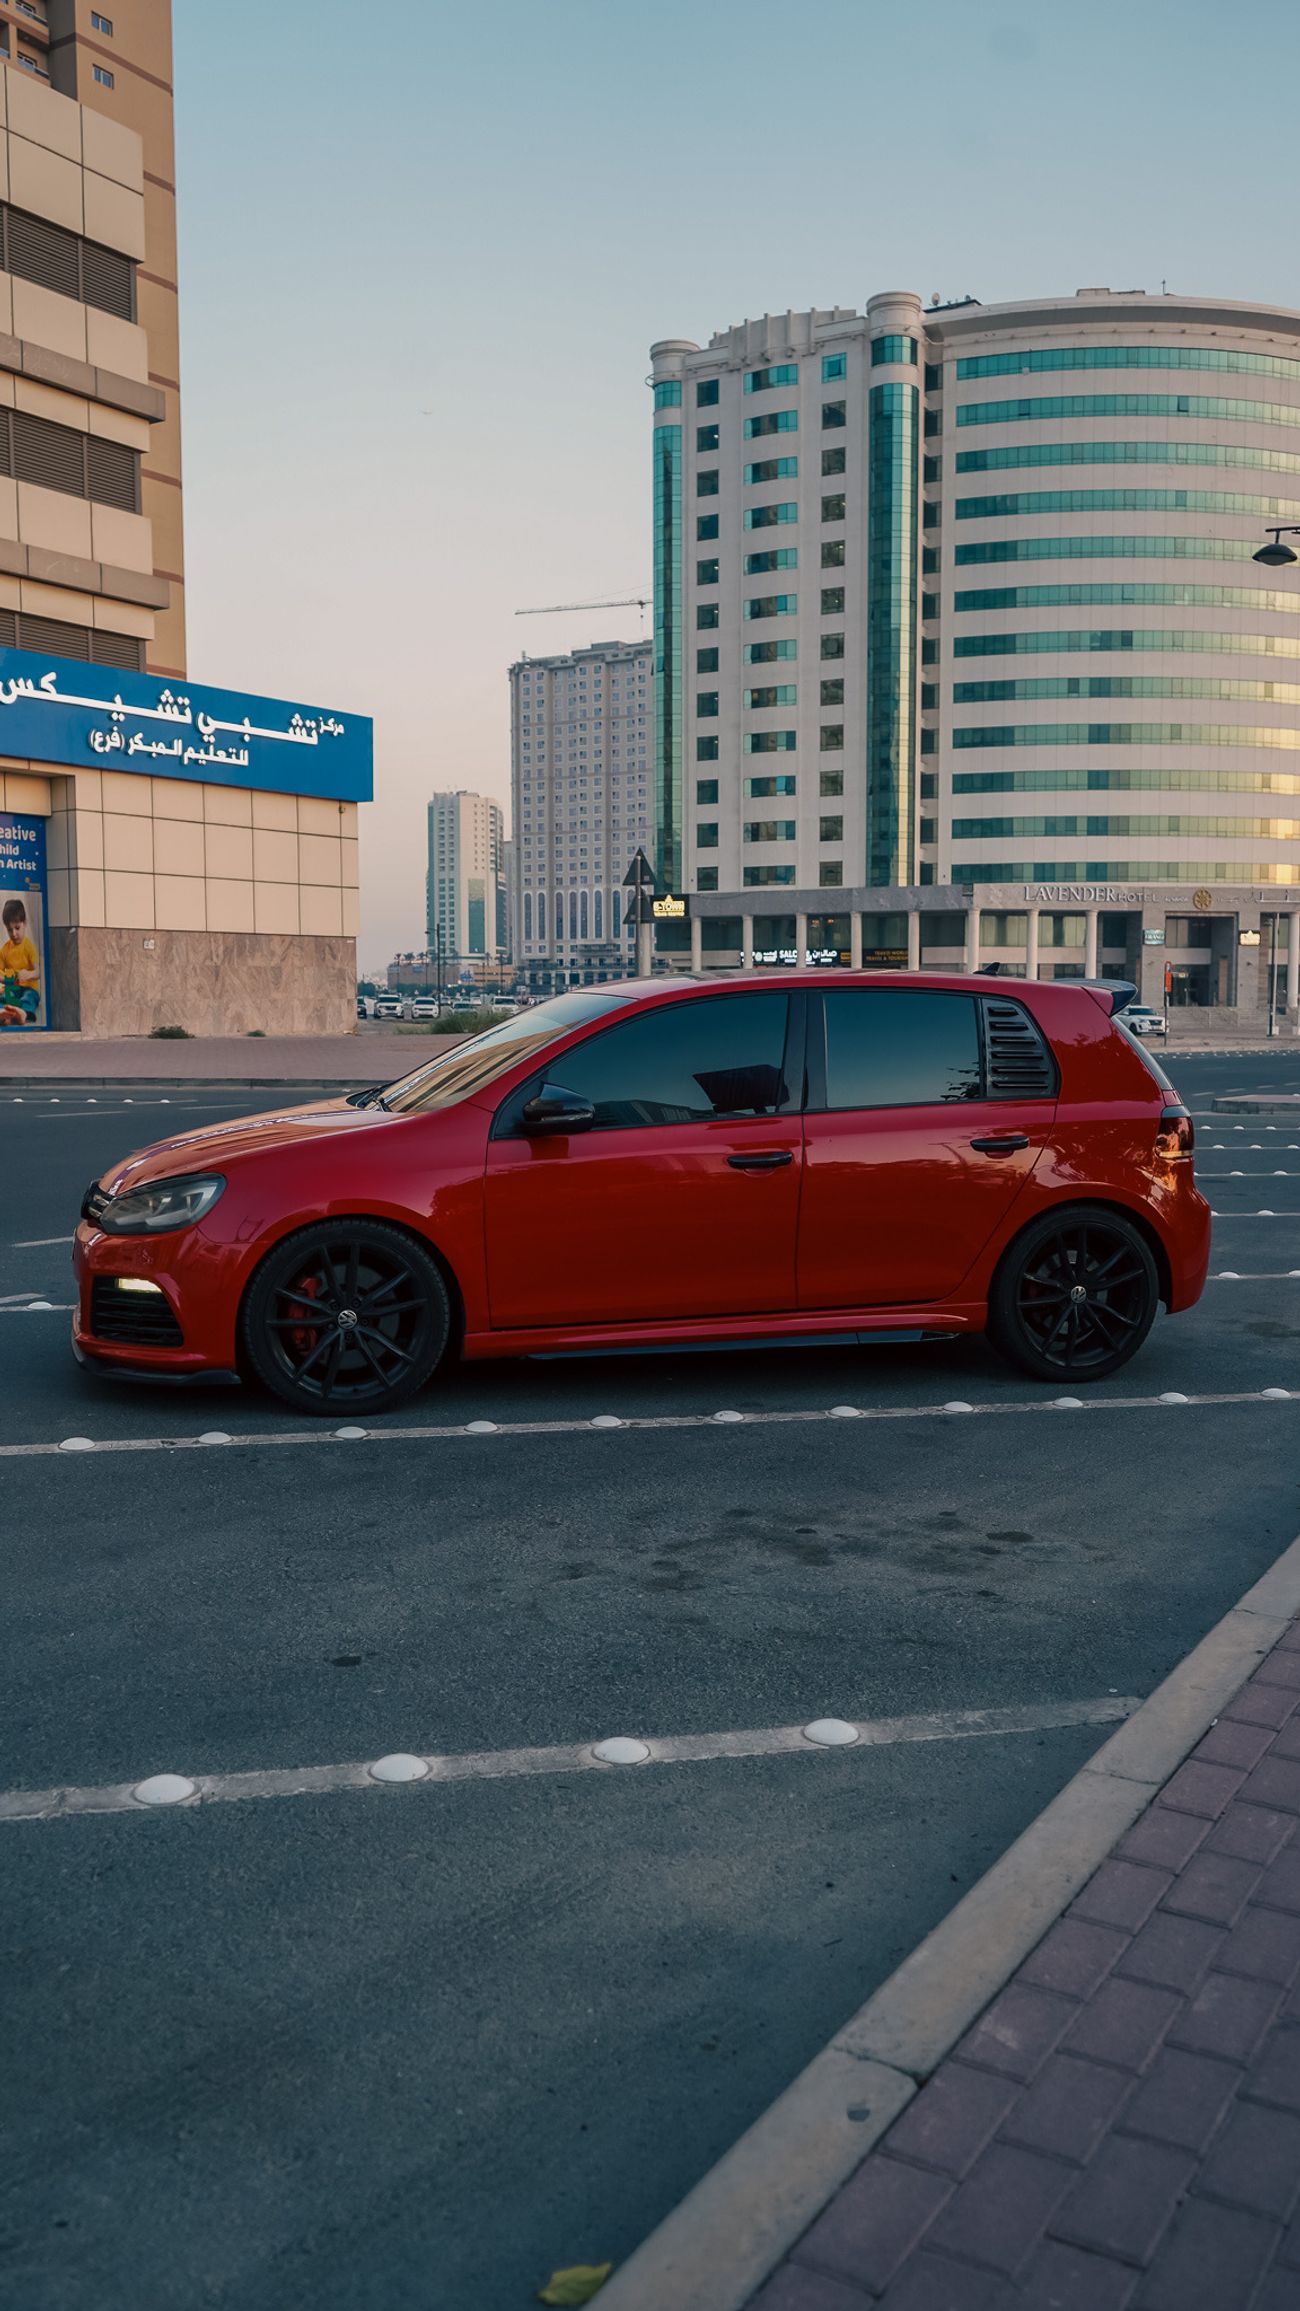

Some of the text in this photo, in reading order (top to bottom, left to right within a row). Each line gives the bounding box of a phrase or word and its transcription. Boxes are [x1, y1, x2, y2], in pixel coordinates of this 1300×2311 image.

[319, 716, 345, 736] مركز
[128, 732, 183, 758] المبكر
[183, 743, 249, 767] للتعليم
[0, 825, 36, 841] eative
[0, 844, 20, 856] hild
[6, 859, 37, 871] Artist
[1024, 885, 1117, 902] LAVENDER
[1118, 892, 1159, 903] HOTEL
